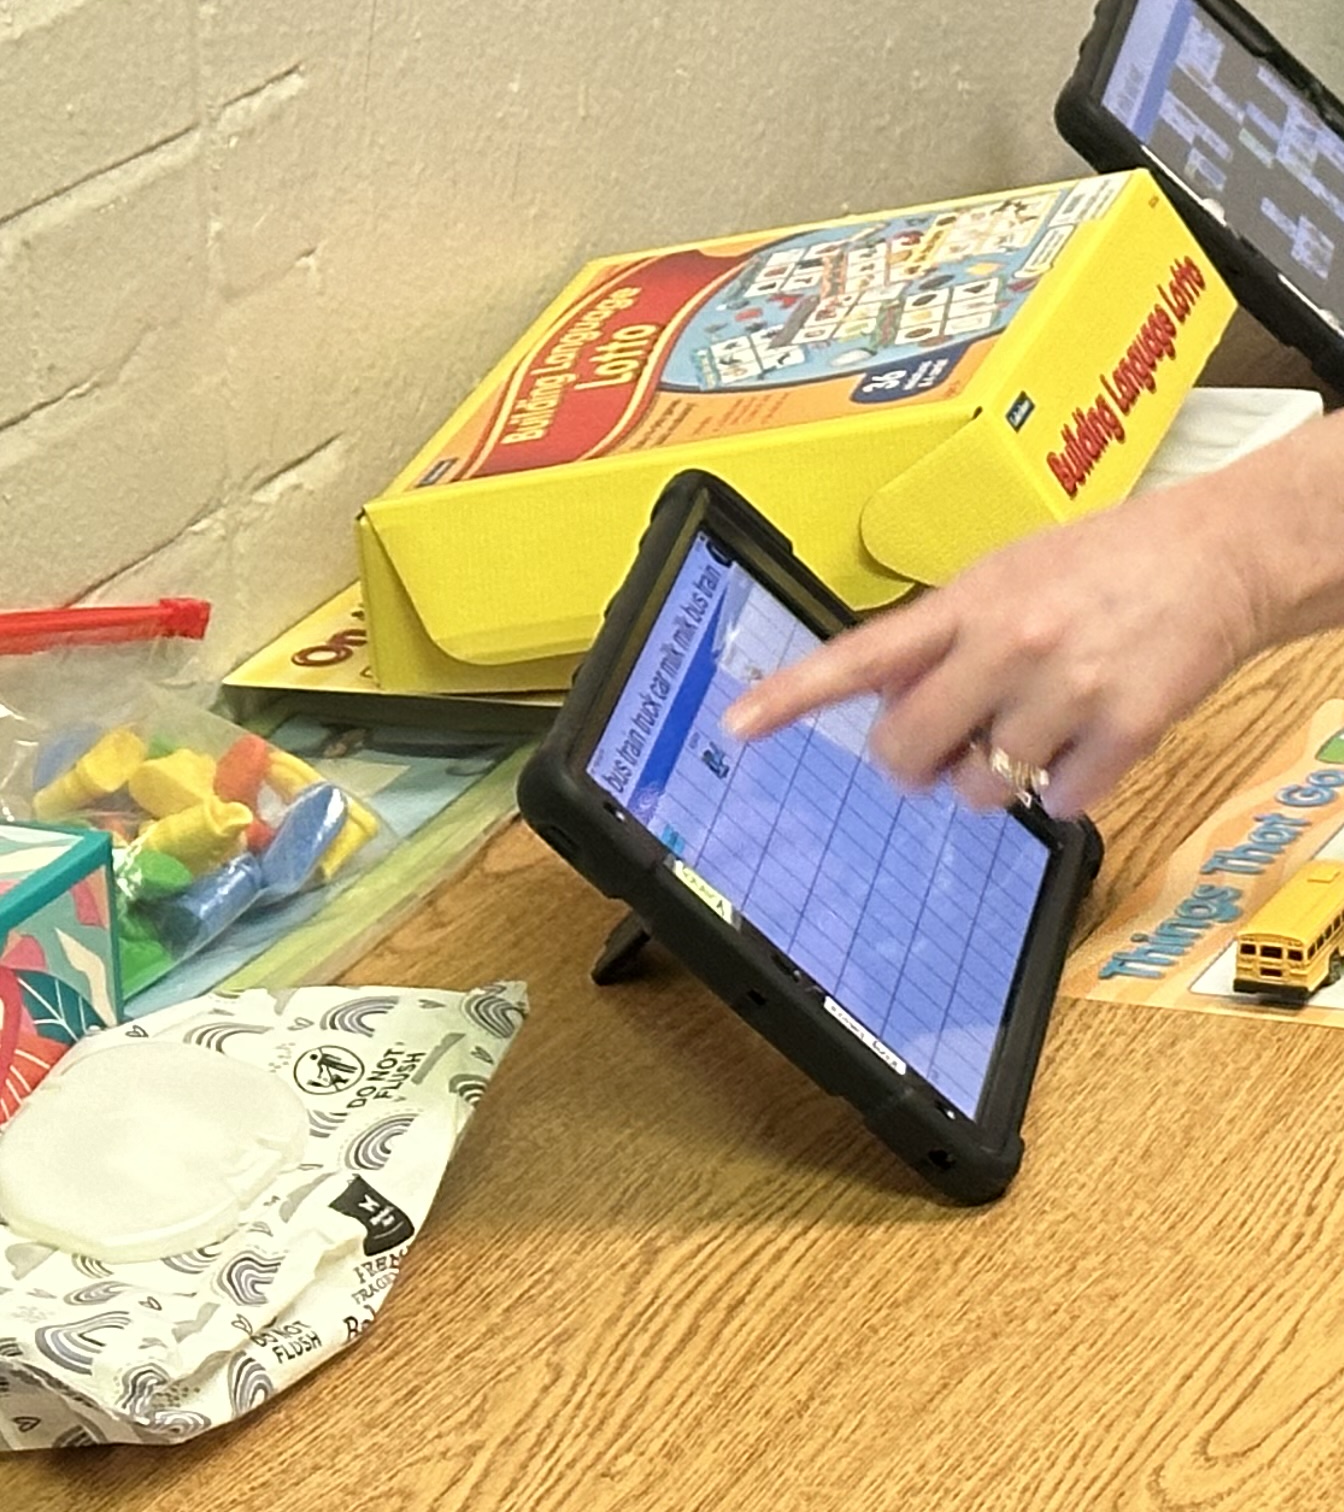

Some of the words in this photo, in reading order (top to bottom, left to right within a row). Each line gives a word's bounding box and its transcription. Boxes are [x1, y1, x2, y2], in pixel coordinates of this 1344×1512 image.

[530, 287, 643, 375] Language
[574, 324, 657, 390] Lotto
[862, 370, 907, 393] 36
[1047, 393, 1126, 501] Building
[1100, 303, 1177, 417] Language
[1157, 255, 1206, 325] Lotto
[500, 373, 577, 445] Building
[698, 565, 722, 600] train
[680, 591, 709, 623] bus
[672, 614, 697, 652] milk
[659, 641, 686, 681] milk
[649, 670, 670, 701] car
[630, 691, 661, 736] truck
[616, 726, 645, 767] train
[602, 759, 633, 793] bus
[1098, 884, 1243, 979] Things
[1199, 813, 1312, 875] That
[346, 1086, 377, 1108] DO
[366, 1048, 405, 1082] NOT
[373, 1052, 427, 1100] FLUSH
[249, 1333, 278, 1348] DO
[270, 1320, 312, 1339] NOT
[272, 1330, 323, 1365] FLUSH
